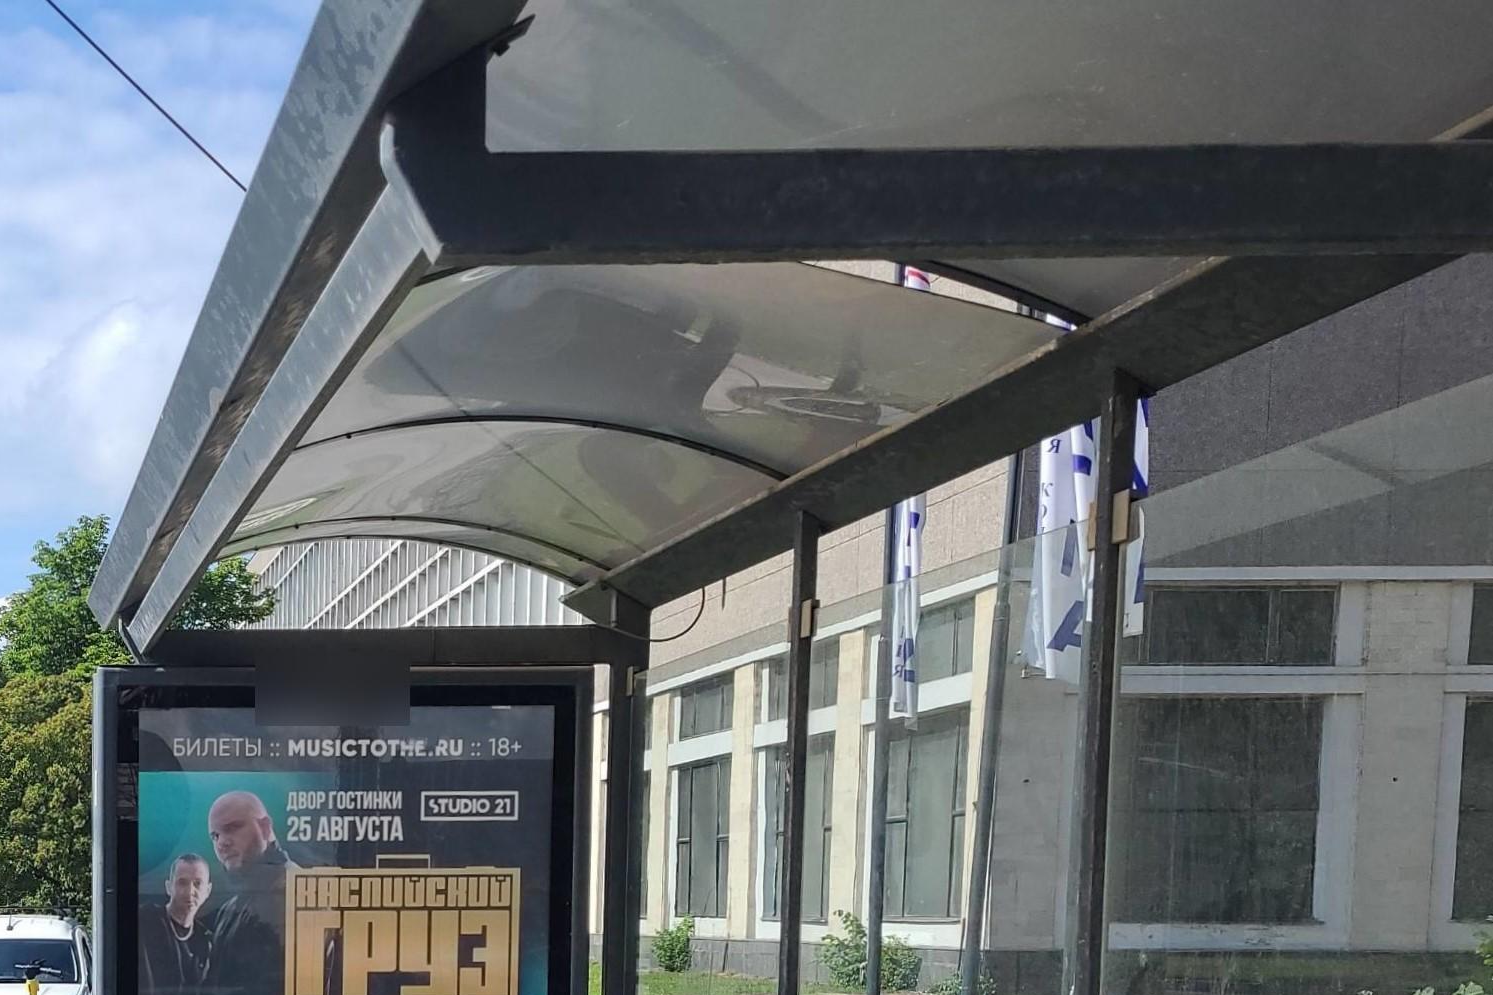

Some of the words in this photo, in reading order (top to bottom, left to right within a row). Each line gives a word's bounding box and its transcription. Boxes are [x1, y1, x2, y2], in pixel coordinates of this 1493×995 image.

[173, 738, 262, 758] БИЛЕТЫ
[288, 739, 464, 758] MUSICTOTHE.RU
[489, 738, 523, 756] 18+
[286, 791, 326, 812] ДВОР
[329, 790, 403, 810] ГОСТИНКИ
[428, 799, 489, 815] STUDIO
[494, 798, 511, 814] 21
[287, 817, 312, 842] 25
[317, 815, 404, 842] АВГУСТА
[296, 876, 511, 908] КАСПИЙСКИЙ
